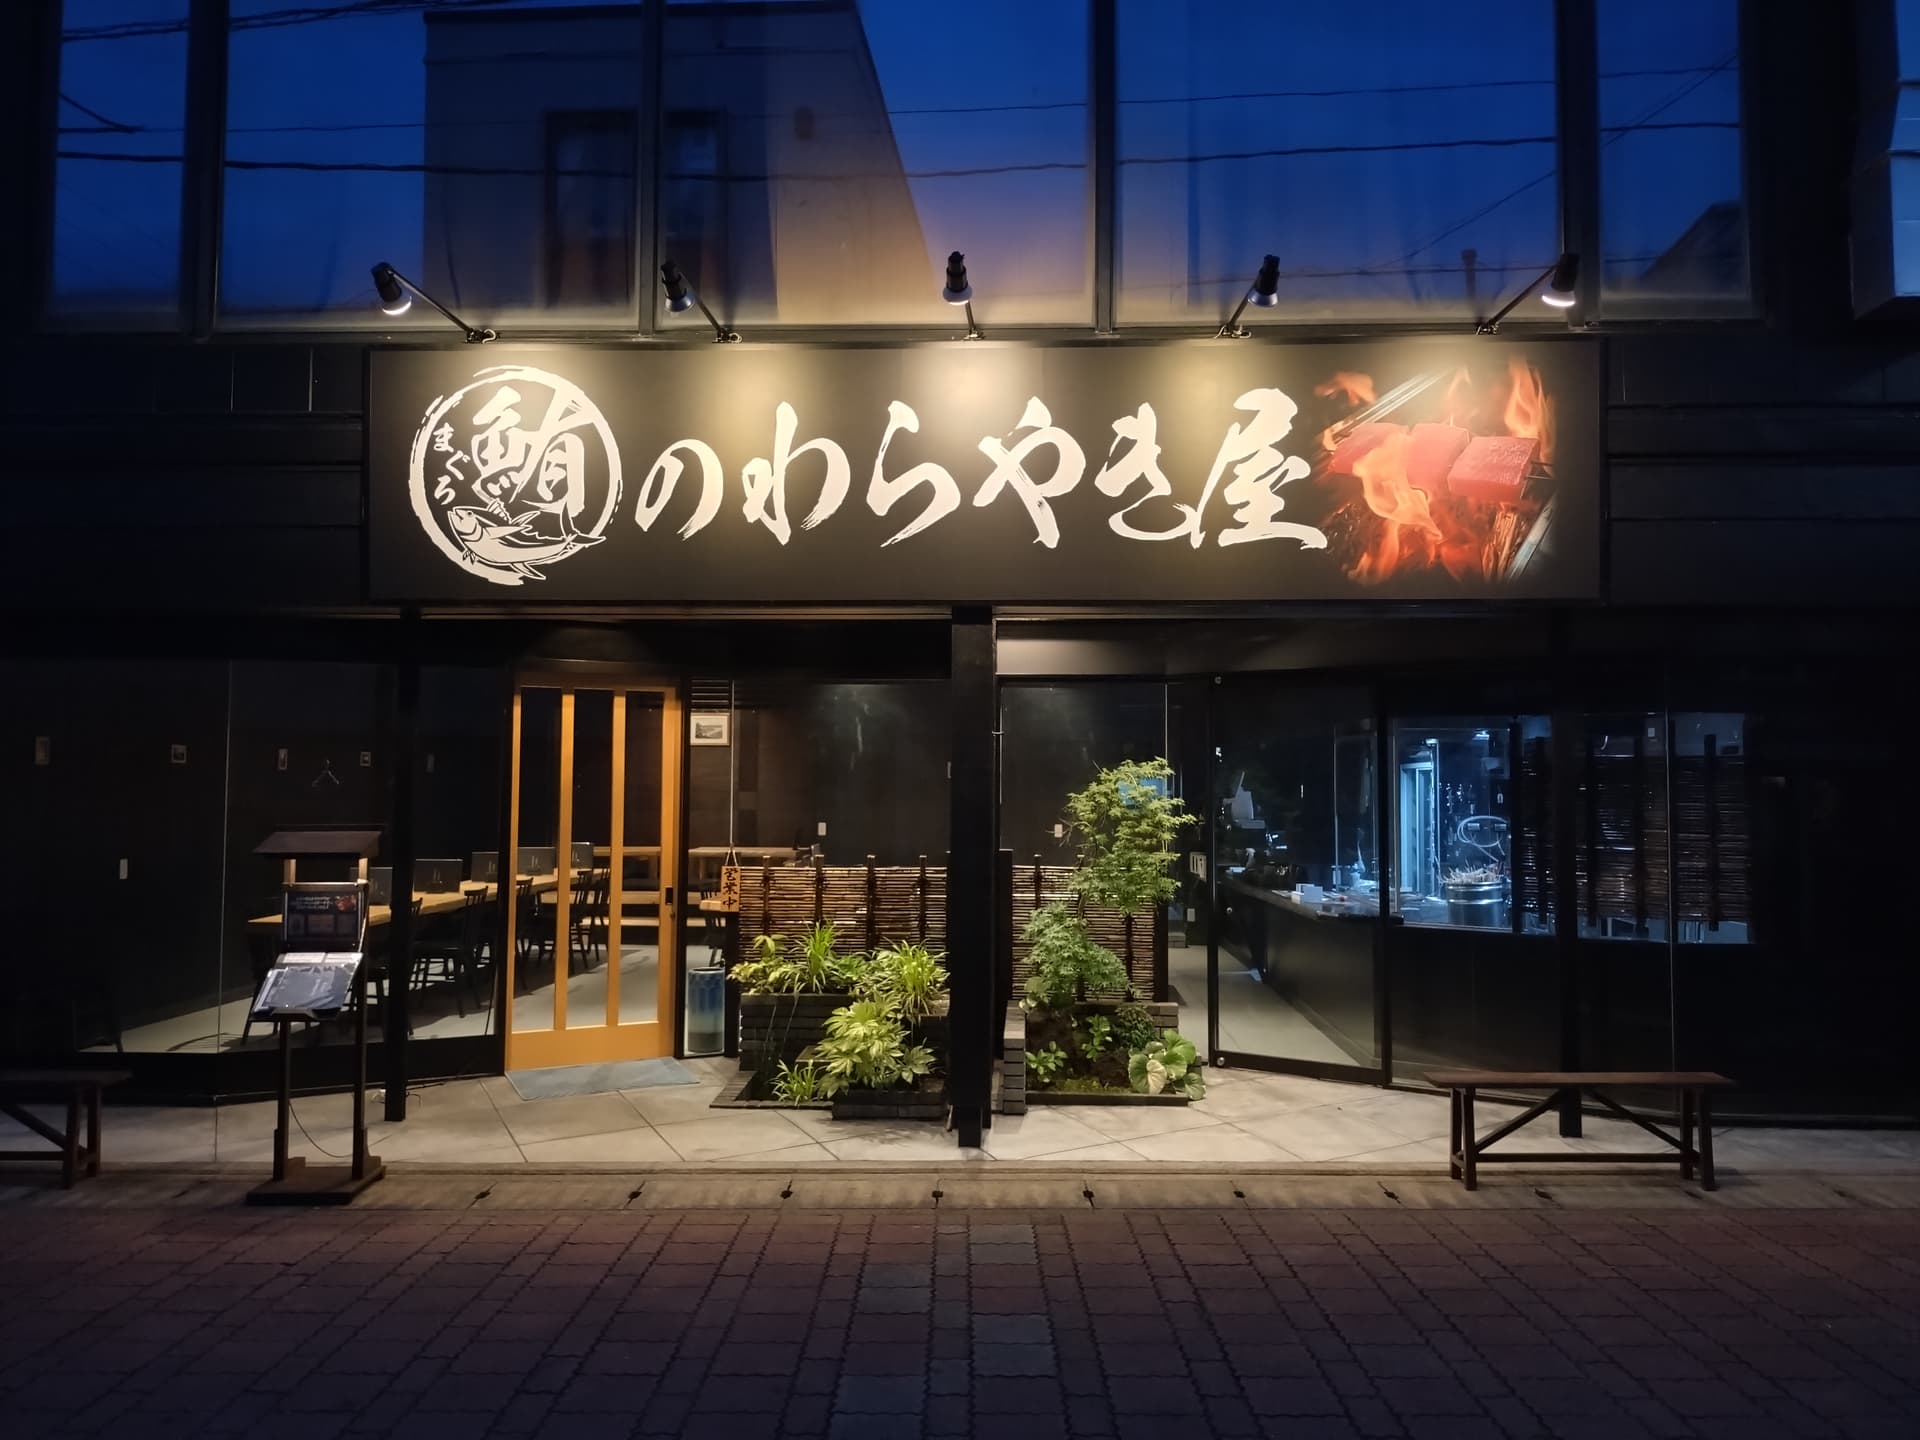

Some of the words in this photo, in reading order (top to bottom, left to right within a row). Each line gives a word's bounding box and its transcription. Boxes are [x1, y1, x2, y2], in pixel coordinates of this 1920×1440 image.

[432, 422, 471, 505] まぐろ
[723, 867, 738, 910] 営業中
